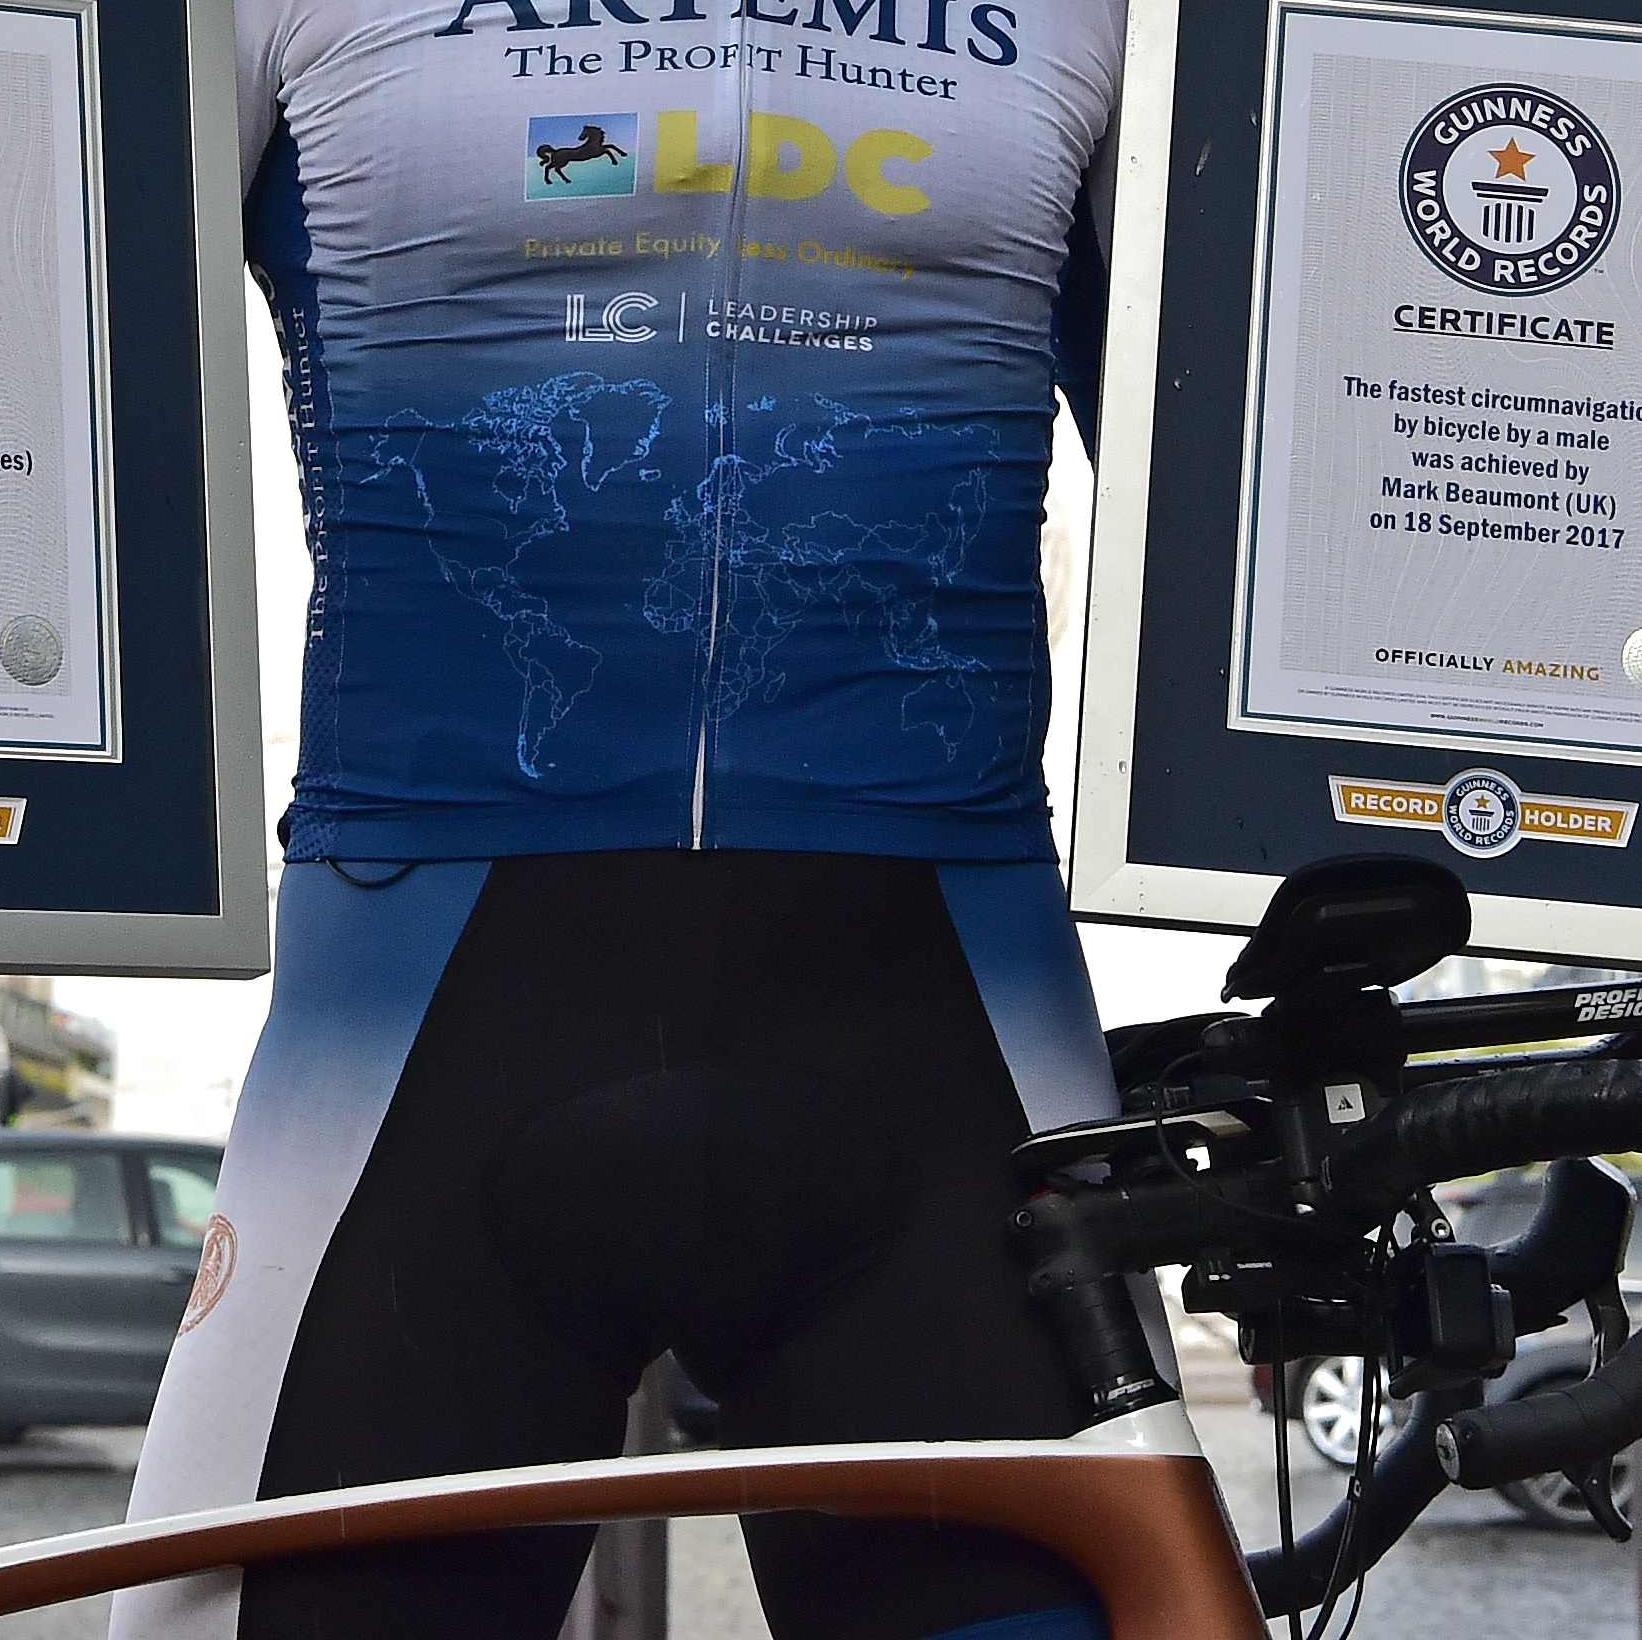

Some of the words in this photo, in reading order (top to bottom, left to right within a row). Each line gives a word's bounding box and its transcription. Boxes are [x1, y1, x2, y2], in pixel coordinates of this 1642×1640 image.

[504, 46, 602, 78] The
[795, 44, 959, 100] Hunter
[1434, 97, 1592, 157] GUINNESS
[655, 109, 934, 215] LDC
[524, 236, 623, 260] Private
[636, 230, 722, 259] Equity
[1413, 170, 1482, 272] WORLD
[1494, 184, 1607, 284] RECORDS
[565, 291, 658, 343] LC
[708, 299, 878, 330] LEADERSHIP
[1394, 304, 1614, 345] CERTIFICATE
[706, 320, 874, 352] CHALLENGES
[1343, 375, 1382, 399] The
[1388, 379, 1465, 407] fastest
[1394, 412, 1418, 439] by
[1423, 415, 1501, 443] bicycle
[1507, 422, 1531, 448] by
[1536, 427, 1549, 446] a
[1556, 428, 1611, 451] male
[1411, 450, 1454, 470] was
[1460, 452, 1559, 479] achieved
[1564, 460, 1590, 485] by
[1381, 476, 1439, 501] Mark
[1445, 482, 1559, 511] Beaumont
[1565, 492, 1617, 521] (UK)
[1370, 511, 1396, 530] on
[1404, 511, 1432, 533] 18
[1438, 514, 1561, 544] September
[1565, 525, 1625, 550] 2017
[1375, 647, 1495, 673] OFFICIALLY
[1502, 658, 1601, 681] AMAZING
[1456, 780, 1508, 802] GUINNESS
[1350, 792, 1438, 815] RECORD
[1525, 809, 1612, 832] HOLDER
[1449, 805, 1473, 845] WORLD
[1476, 810, 1514, 845] RECORDS
